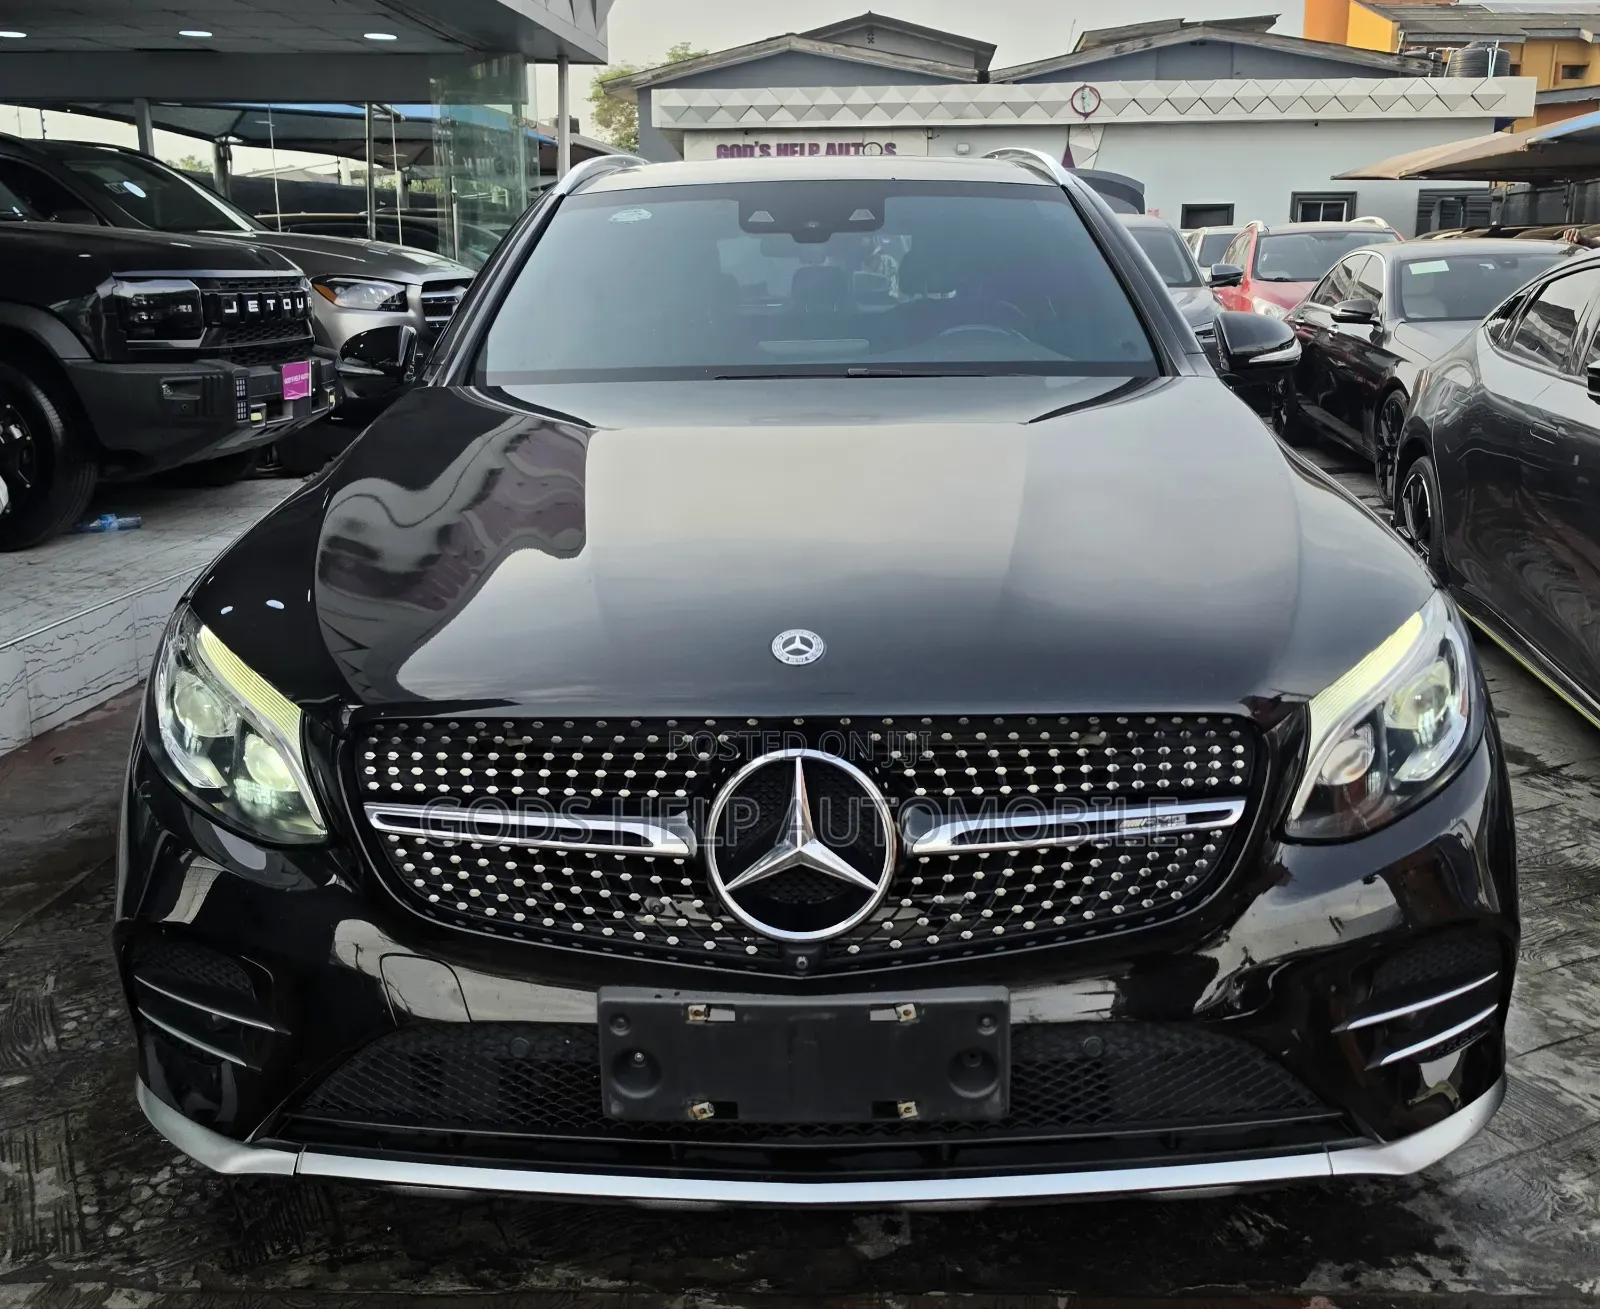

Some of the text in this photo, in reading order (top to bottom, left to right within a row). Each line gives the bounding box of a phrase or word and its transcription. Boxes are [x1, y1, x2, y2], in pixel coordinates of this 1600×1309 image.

[716, 141, 771, 158] GOD'S
[776, 143, 820, 157] HELP
[224, 297, 312, 314] JETOUR
